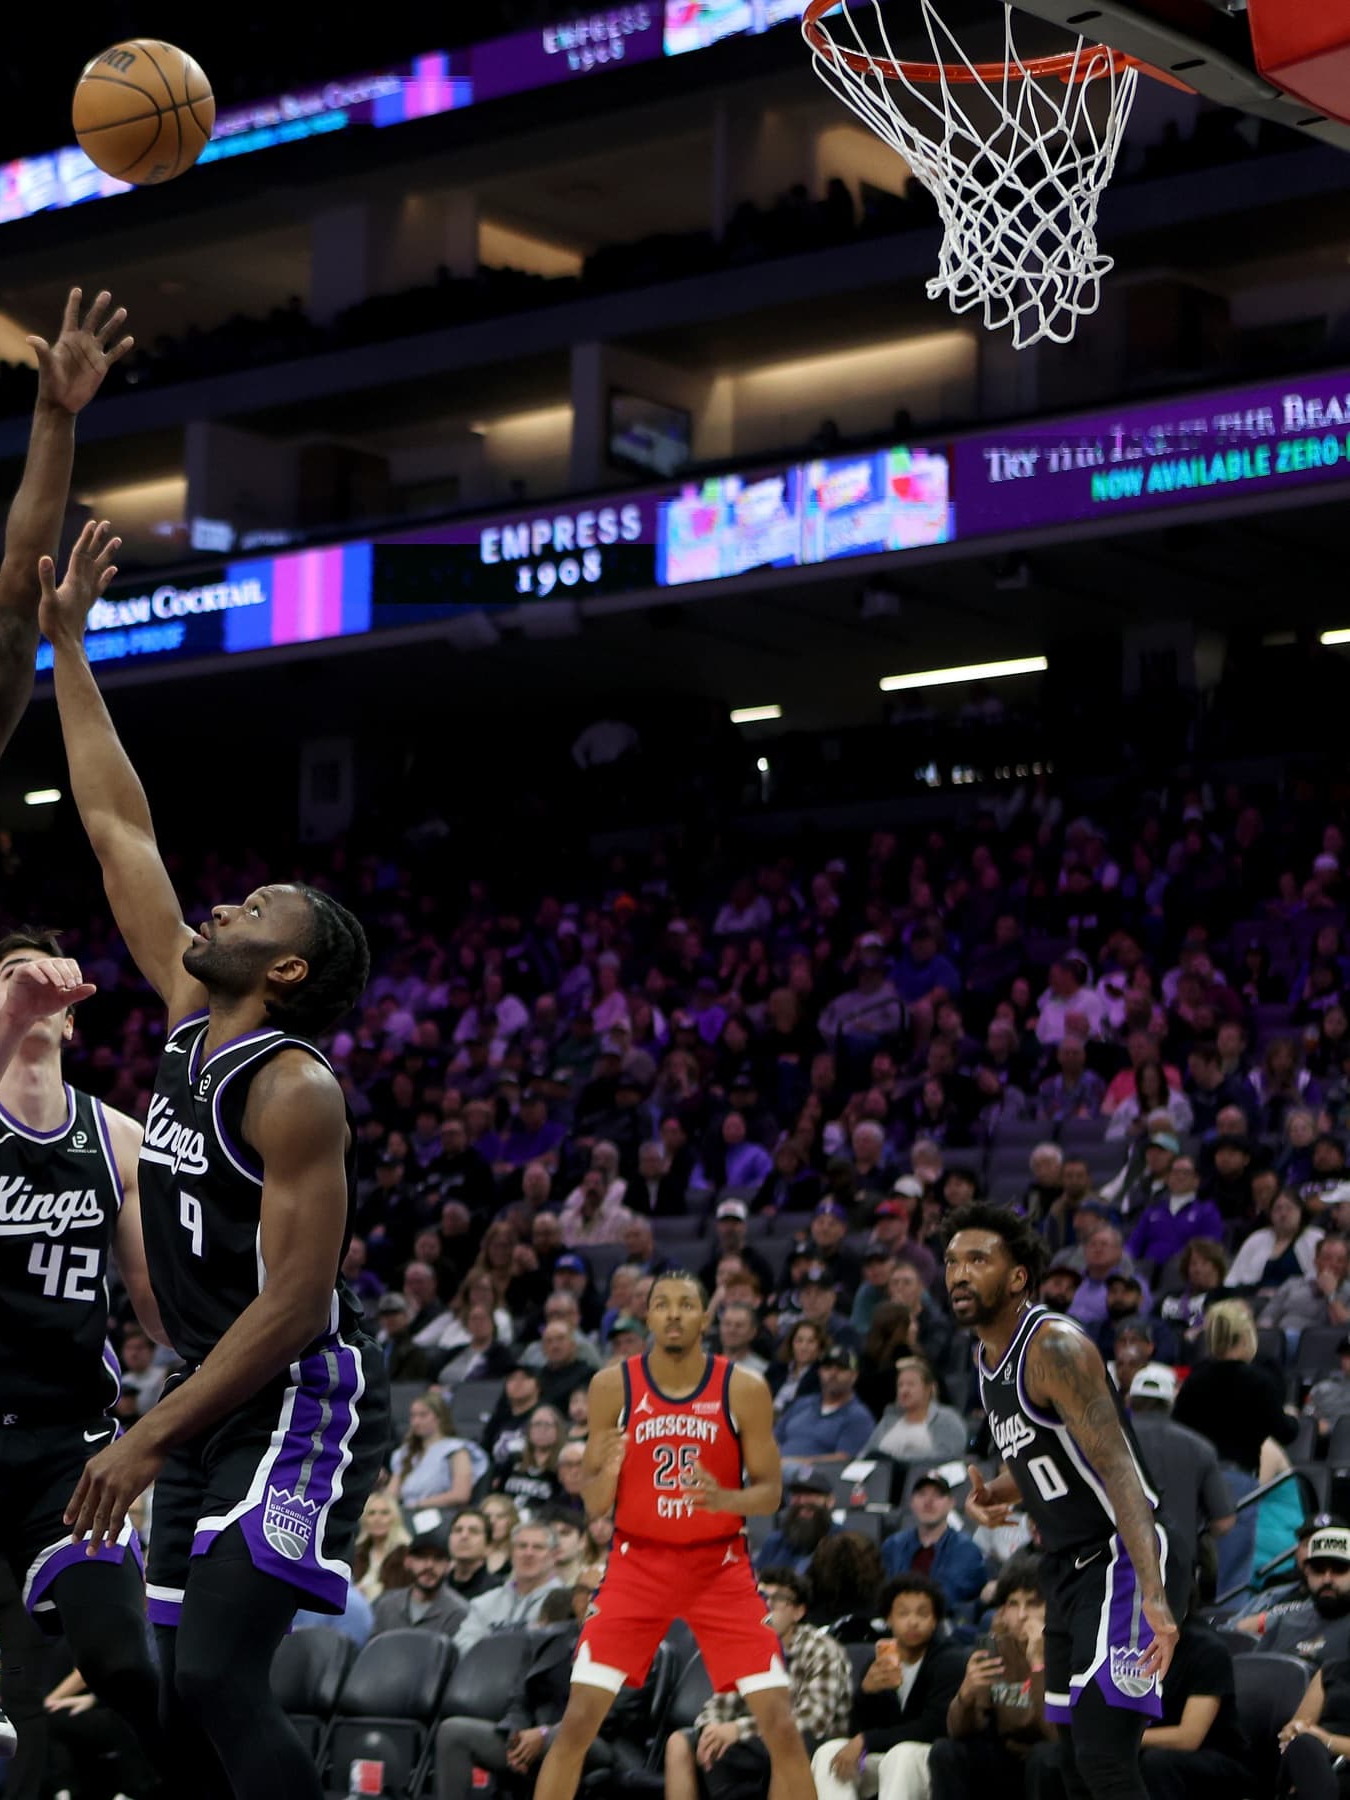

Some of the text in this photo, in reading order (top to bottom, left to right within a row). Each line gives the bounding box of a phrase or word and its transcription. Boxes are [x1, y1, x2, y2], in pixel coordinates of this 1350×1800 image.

[1281, 393, 1350, 434] BEA
[1146, 443, 1272, 495] AVAILABLE
[480, 504, 642, 564] EMPRESS
[516, 549, 602, 597] 1908
[179, 1191, 204, 1258] 9
[28, 1242, 100, 1302] 42
[635, 1414, 720, 1445] CRESCENT
[653, 1444, 701, 1490] 25
[1027, 1455, 1069, 1501] 0
[657, 1495, 694, 1520] CITY
